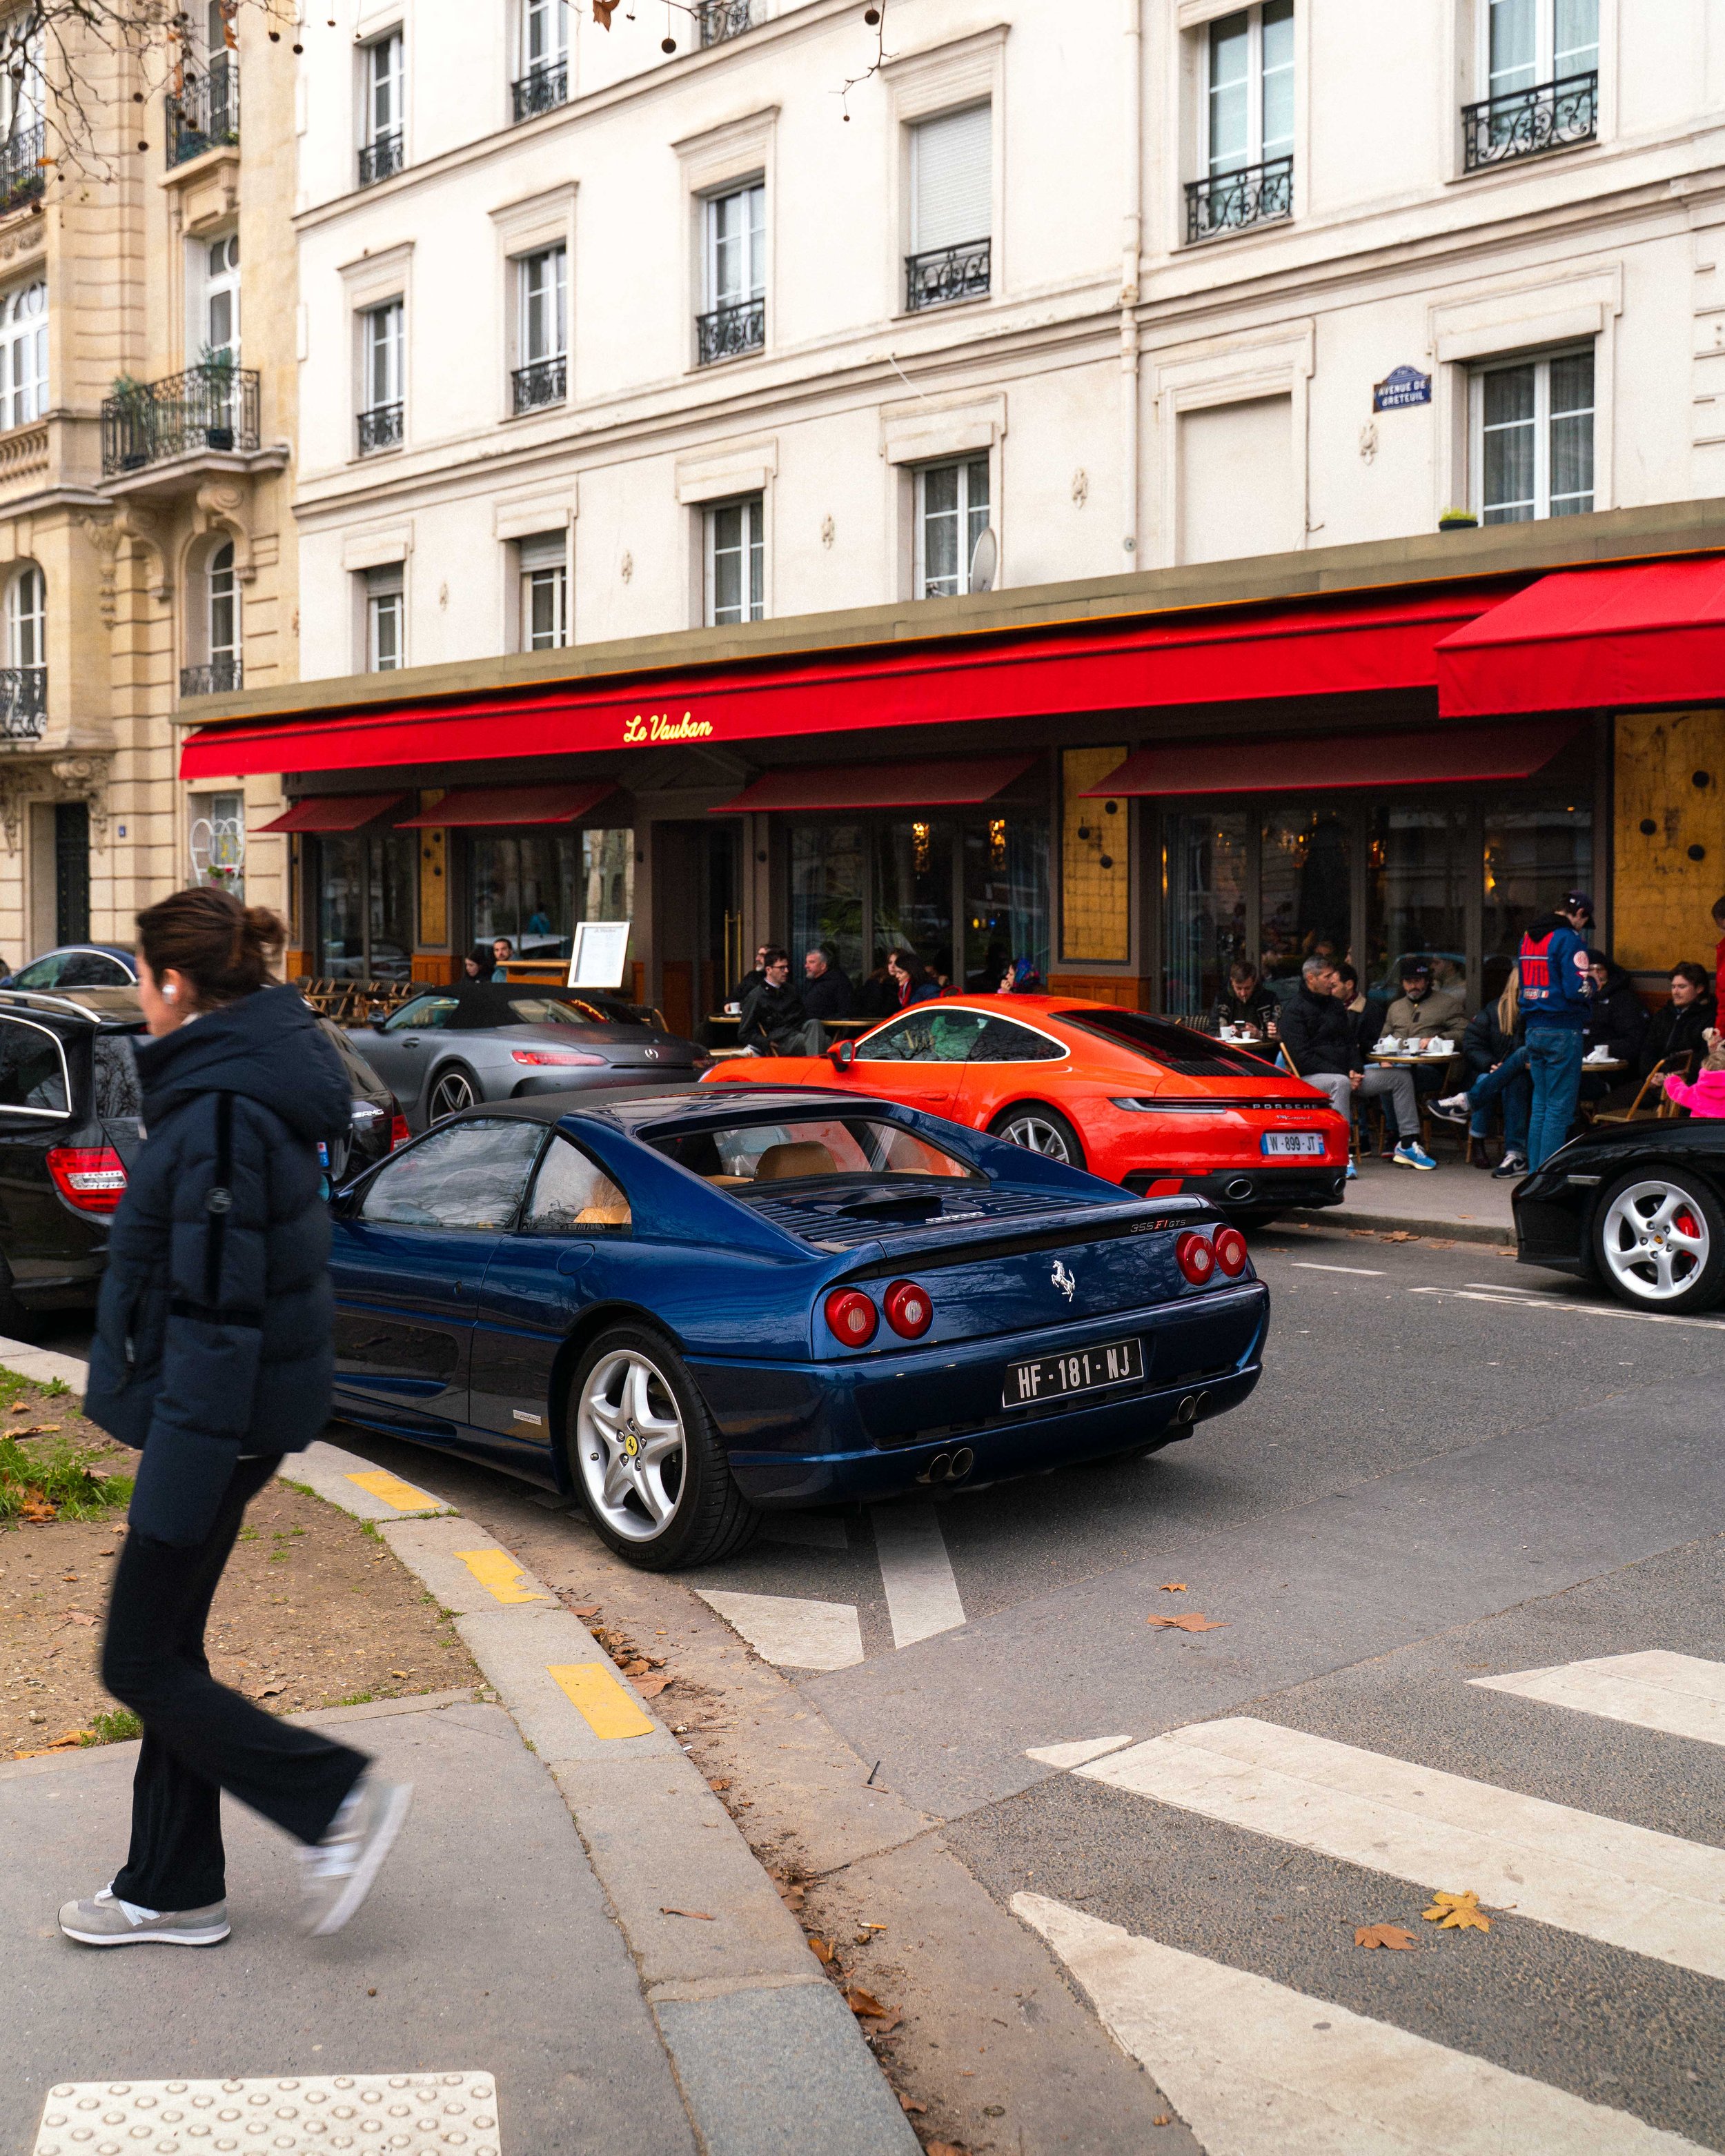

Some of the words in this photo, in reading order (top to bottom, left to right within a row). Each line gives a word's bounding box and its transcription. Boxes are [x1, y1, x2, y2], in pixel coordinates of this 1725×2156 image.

[1378, 381, 1412, 397] AVENUE
[1413, 379, 1427, 390] DE
[1381, 390, 1425, 407] BRETEUIL
[623, 715, 648, 743] Le
[649, 711, 713, 742] Vauban
[362, 1109, 384, 1118] AMG
[1168, 1219, 1187, 1227] GTS
